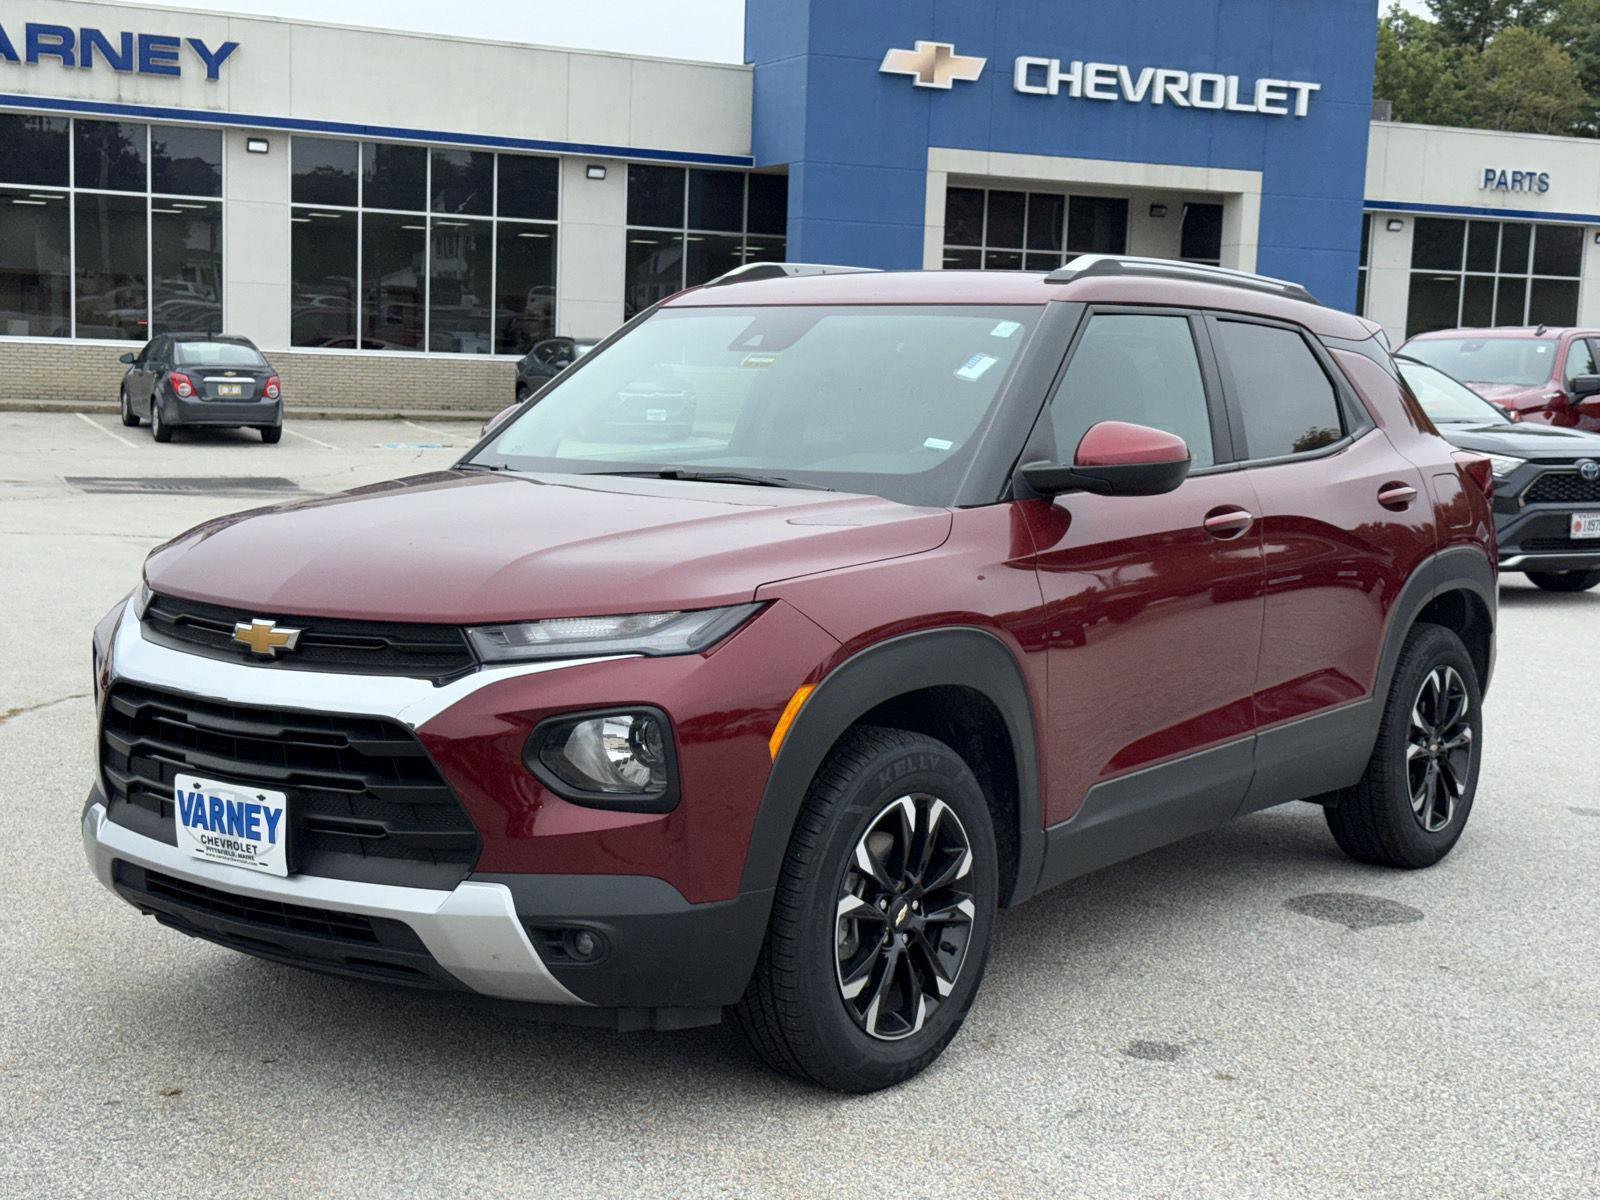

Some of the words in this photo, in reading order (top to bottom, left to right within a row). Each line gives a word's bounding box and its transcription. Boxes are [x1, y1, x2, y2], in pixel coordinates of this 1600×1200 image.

[1013, 54, 1322, 118] CHEVROLET
[1481, 167, 1551, 194] PARTS
[878, 754, 941, 788] KELLY
[176, 789, 283, 845] VARNEY
[200, 834, 258, 856] CHEVROLET
